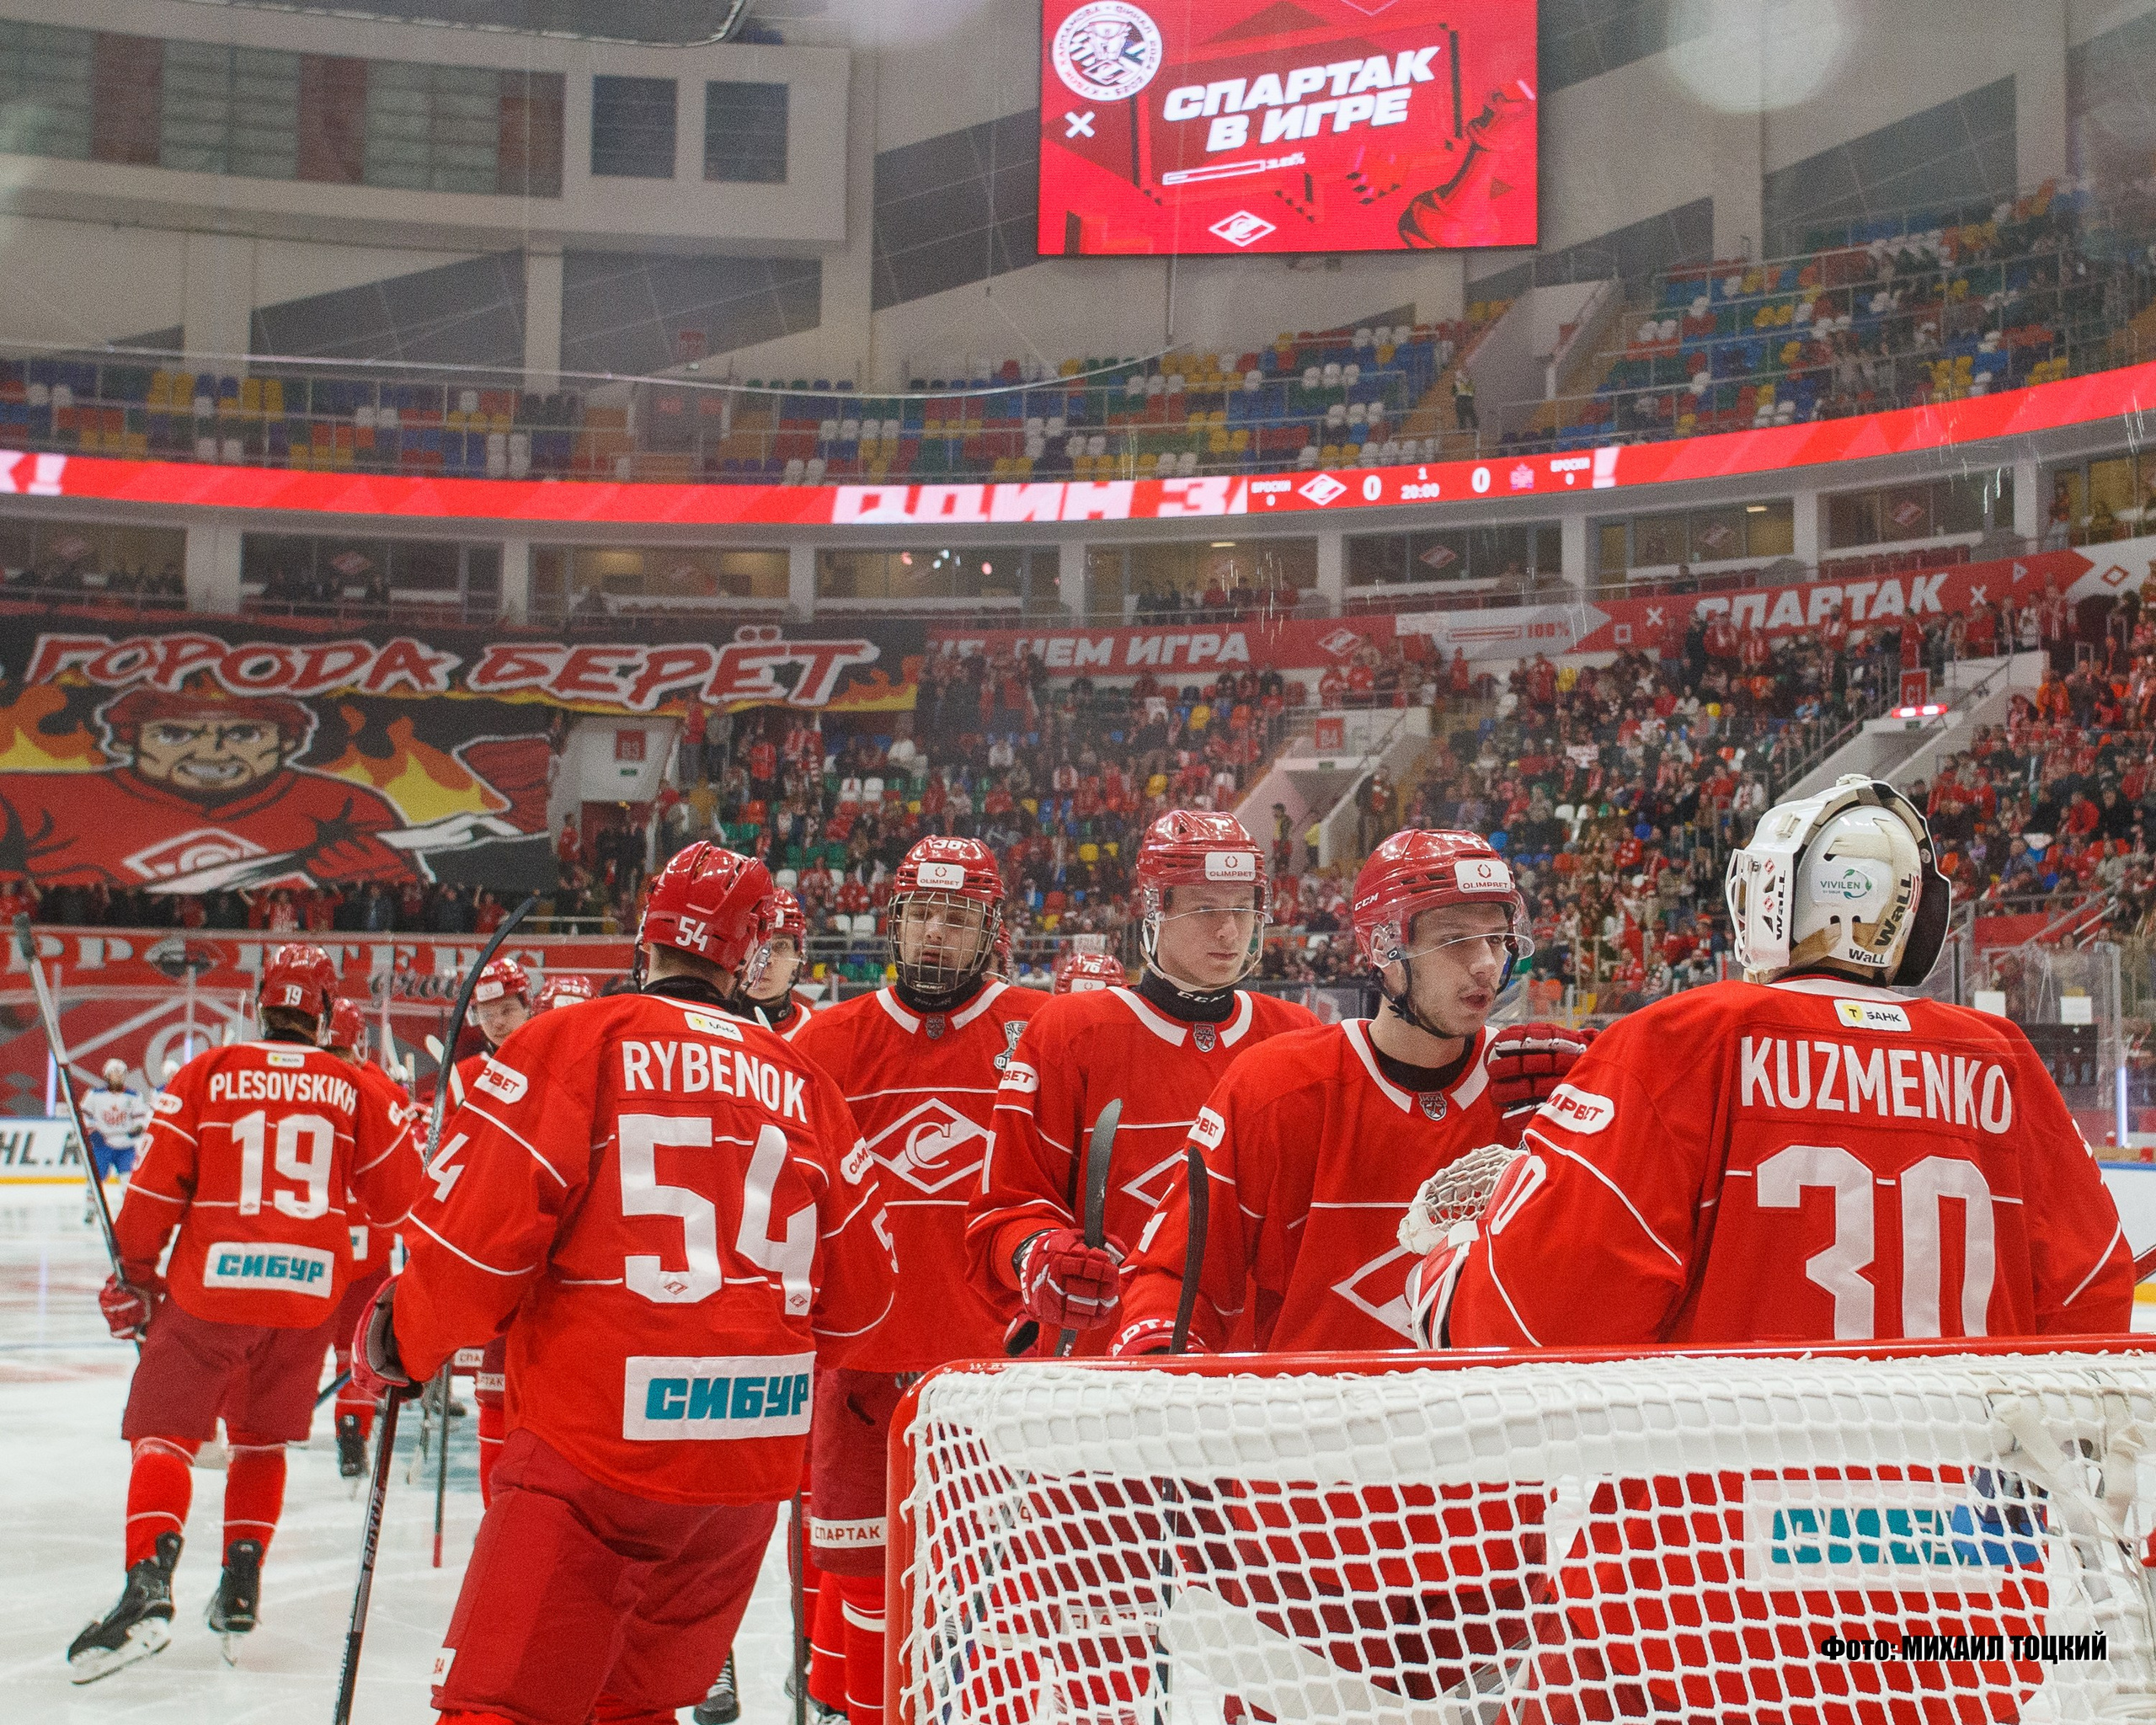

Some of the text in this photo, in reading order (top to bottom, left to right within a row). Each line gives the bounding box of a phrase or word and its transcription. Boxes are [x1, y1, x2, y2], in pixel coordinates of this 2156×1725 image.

[1163, 45, 1441, 122] СПАРТАК
[1206, 88, 1412, 152] В ИГРЕ
[1417, 467, 1428, 480] 1
[1471, 467, 1492, 494] 0
[1565, 472, 1575, 485] 0
[1266, 494, 1276, 507] 0
[1363, 474, 1383, 501] 0
[1401, 483, 1440, 500] 20:00
[1125, 632, 1251, 665] ИГРА
[920, 878, 959, 887] OLIMPBET
[1209, 869, 1253, 879] OLIMPBET
[1463, 881, 1508, 890] OLIMPBET
[1820, 879, 1860, 890] VIVILEN
[1354, 892, 1380, 911] CCM
[675, 916, 709, 952] 54
[284, 984, 303, 1007] 19
[1866, 1012, 1902, 1023] БАНК
[210, 1070, 358, 1117] PLESOVSKIKH
[622, 1040, 808, 1124] RYBENOK
[1740, 1035, 2013, 1135] KUZMENKO
[232, 1109, 335, 1220] 19
[617, 1114, 817, 1316] 54
[1757, 1146, 1997, 1341] 30
[216, 1253, 325, 1284] СИБУР
[644, 1373, 809, 1421] СИБУР
[814, 1525, 880, 1541] СПАРТАК
